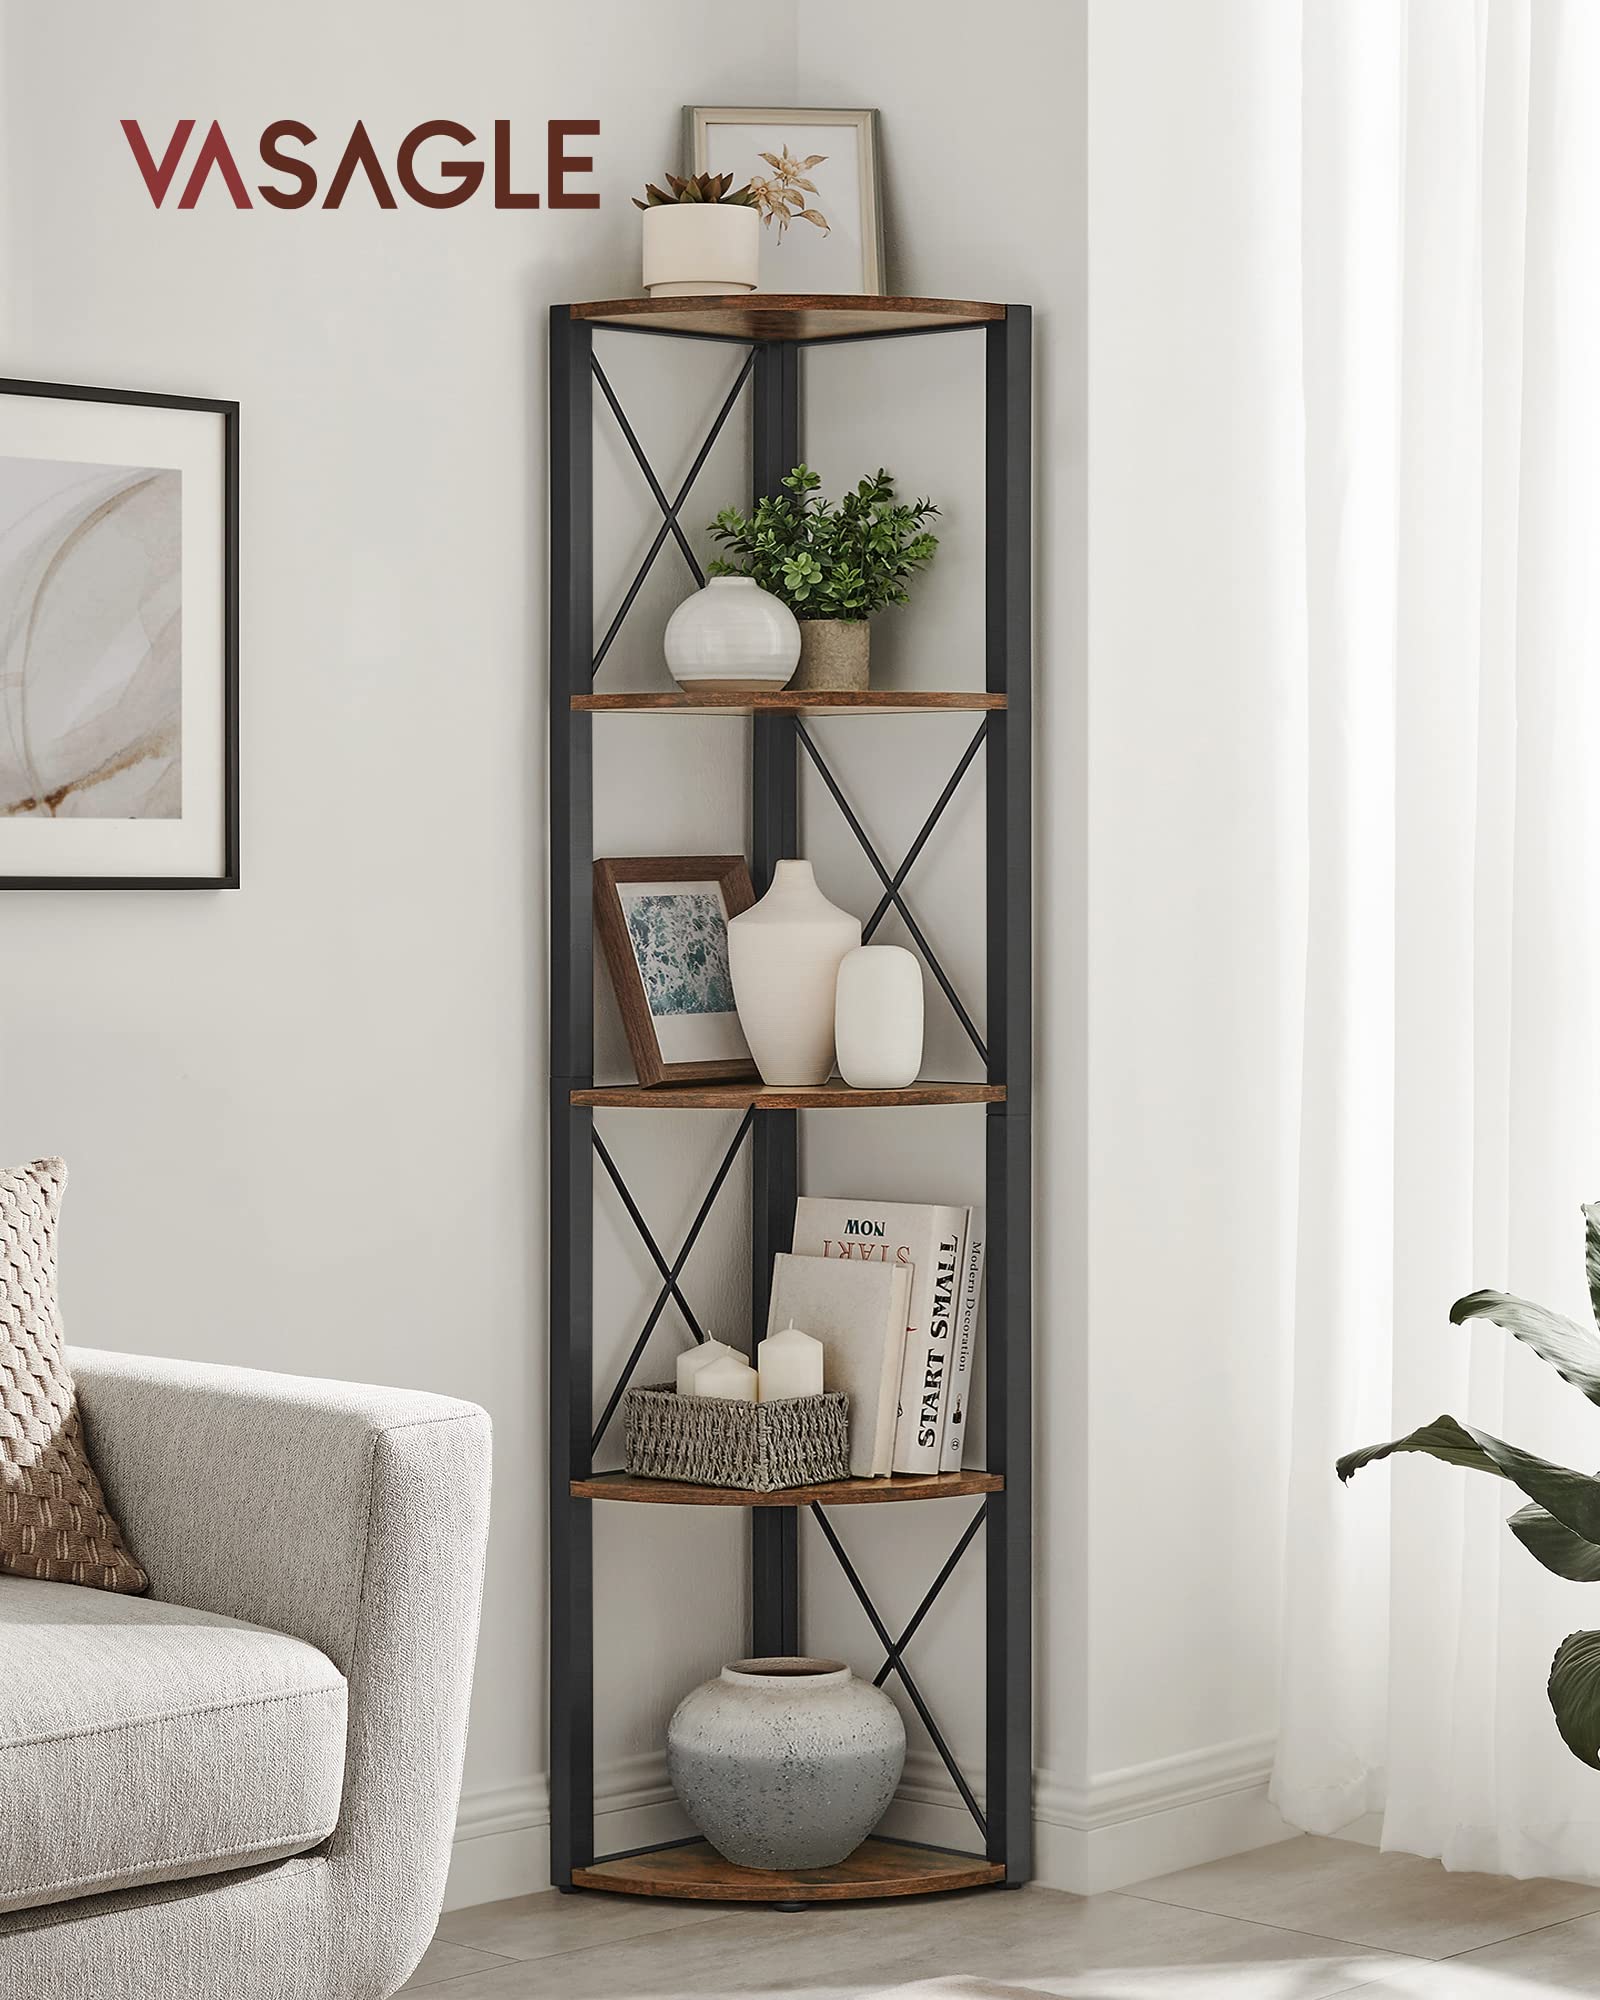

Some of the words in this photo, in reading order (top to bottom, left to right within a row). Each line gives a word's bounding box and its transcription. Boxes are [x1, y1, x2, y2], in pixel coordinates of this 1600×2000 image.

[844, 1219, 886, 1237] NOW
[930, 1234, 958, 1339] SMALL
[967, 1241, 982, 1293] Modern
[958, 1298, 976, 1372] Decoration
[918, 1348, 945, 1449] START
